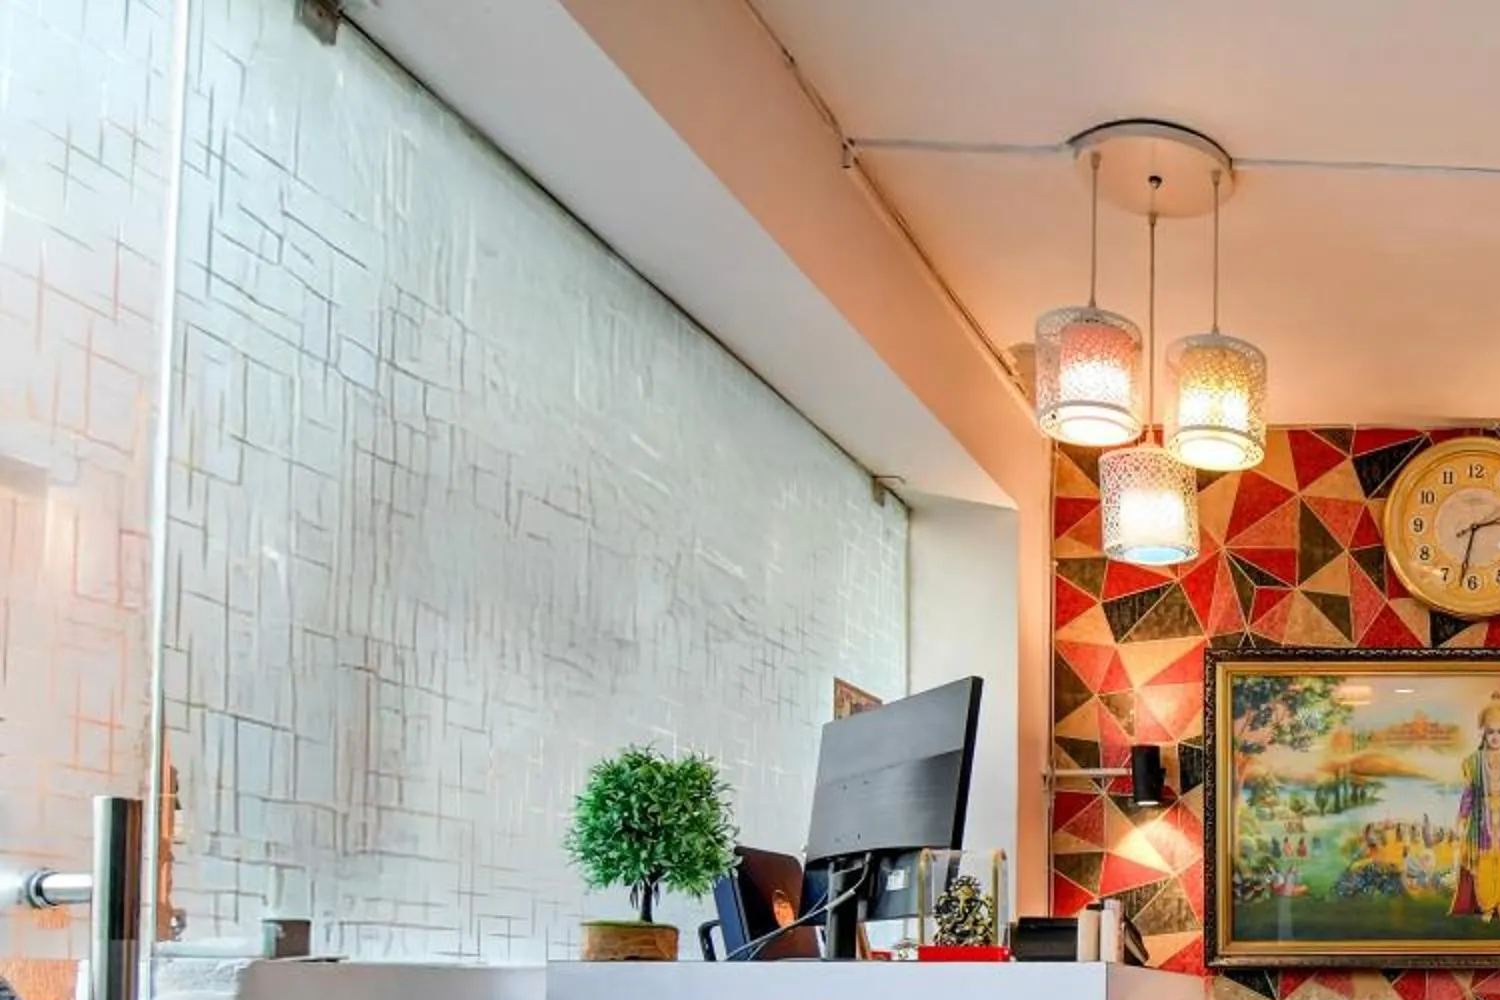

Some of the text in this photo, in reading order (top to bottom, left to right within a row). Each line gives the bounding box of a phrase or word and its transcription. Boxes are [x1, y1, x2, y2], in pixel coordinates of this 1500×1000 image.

[1443, 471, 1454, 485] 11
[1468, 464, 1485, 479] 12
[1421, 490, 1435, 504] 10
[1413, 517, 1423, 532] 9
[1419, 546, 1430, 561] 8
[1440, 567, 1449, 581] 7
[1467, 575, 1478, 590] 6
